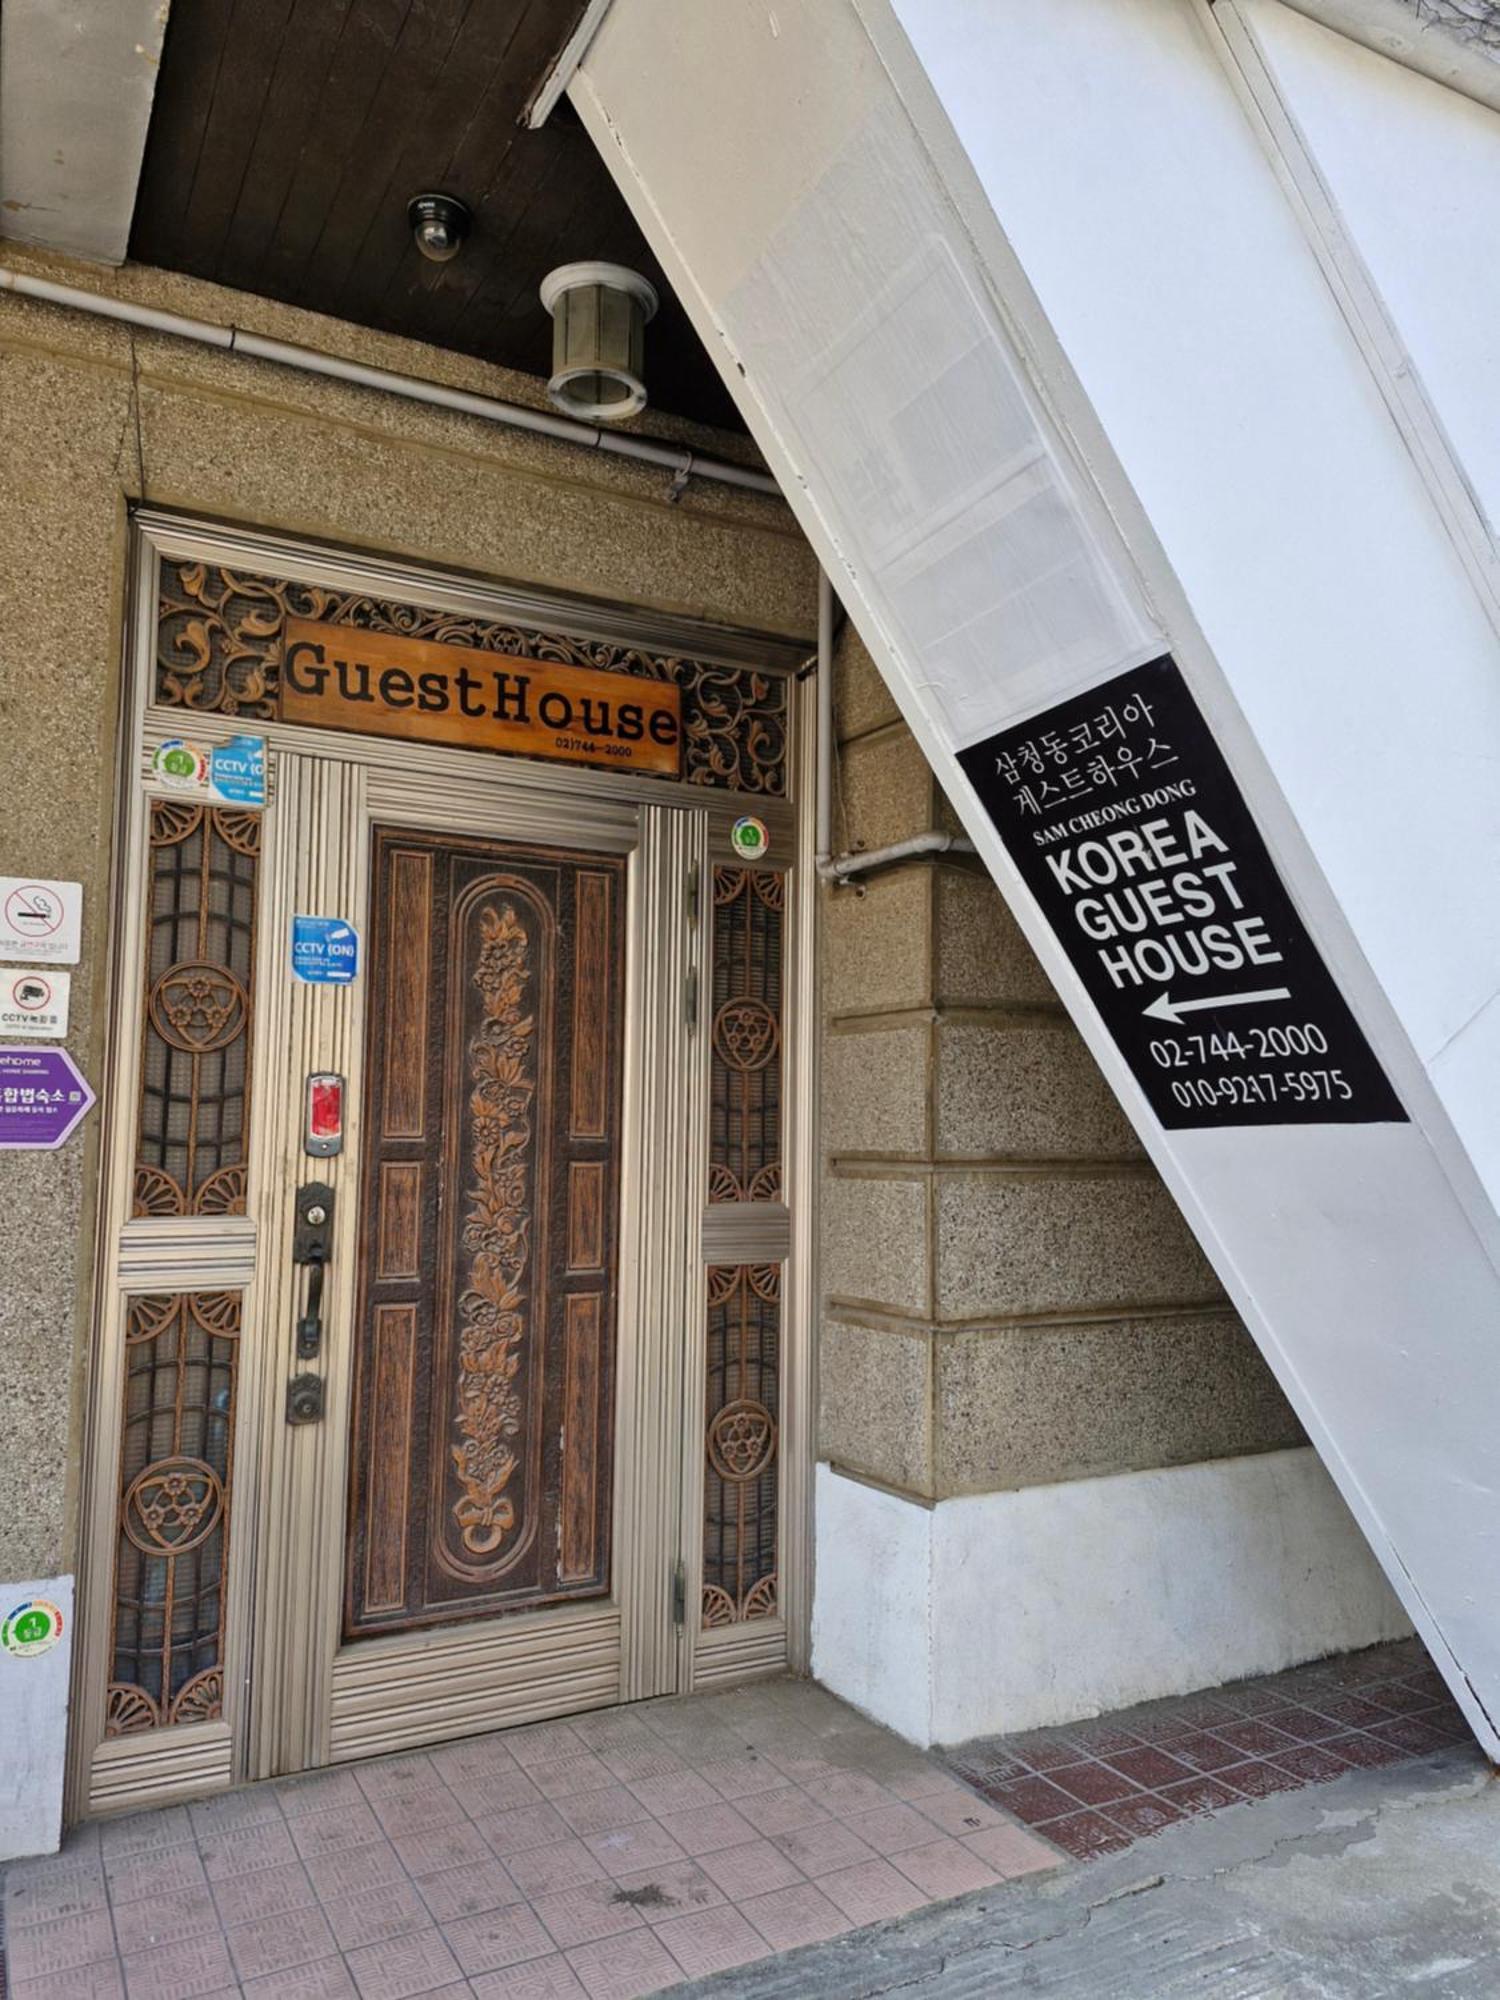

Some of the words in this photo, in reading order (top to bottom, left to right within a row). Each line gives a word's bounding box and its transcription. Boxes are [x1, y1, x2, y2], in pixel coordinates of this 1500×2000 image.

[285, 641, 679, 746] GuestHouse
[215, 758, 247, 773] CCTV
[995, 693, 1154, 784] 삼청동코리아
[1013, 738, 1179, 815] 게스트하우스
[1033, 823, 1068, 846] SAM
[1069, 798, 1141, 834] CHEONG
[1140, 779, 1197, 809] DONG
[1045, 809, 1229, 895] KOREA
[1075, 861, 1244, 941] GUEST
[295, 941, 325, 955] CCTV
[327, 943, 354, 957] (ON)
[1098, 916, 1283, 989] HOUSE
[1150, 1023, 1328, 1068] 02-744-2000
[0, 1087, 66, 1104] 합법숙소
[1171, 1070, 1353, 1108] 010-9217-5975
